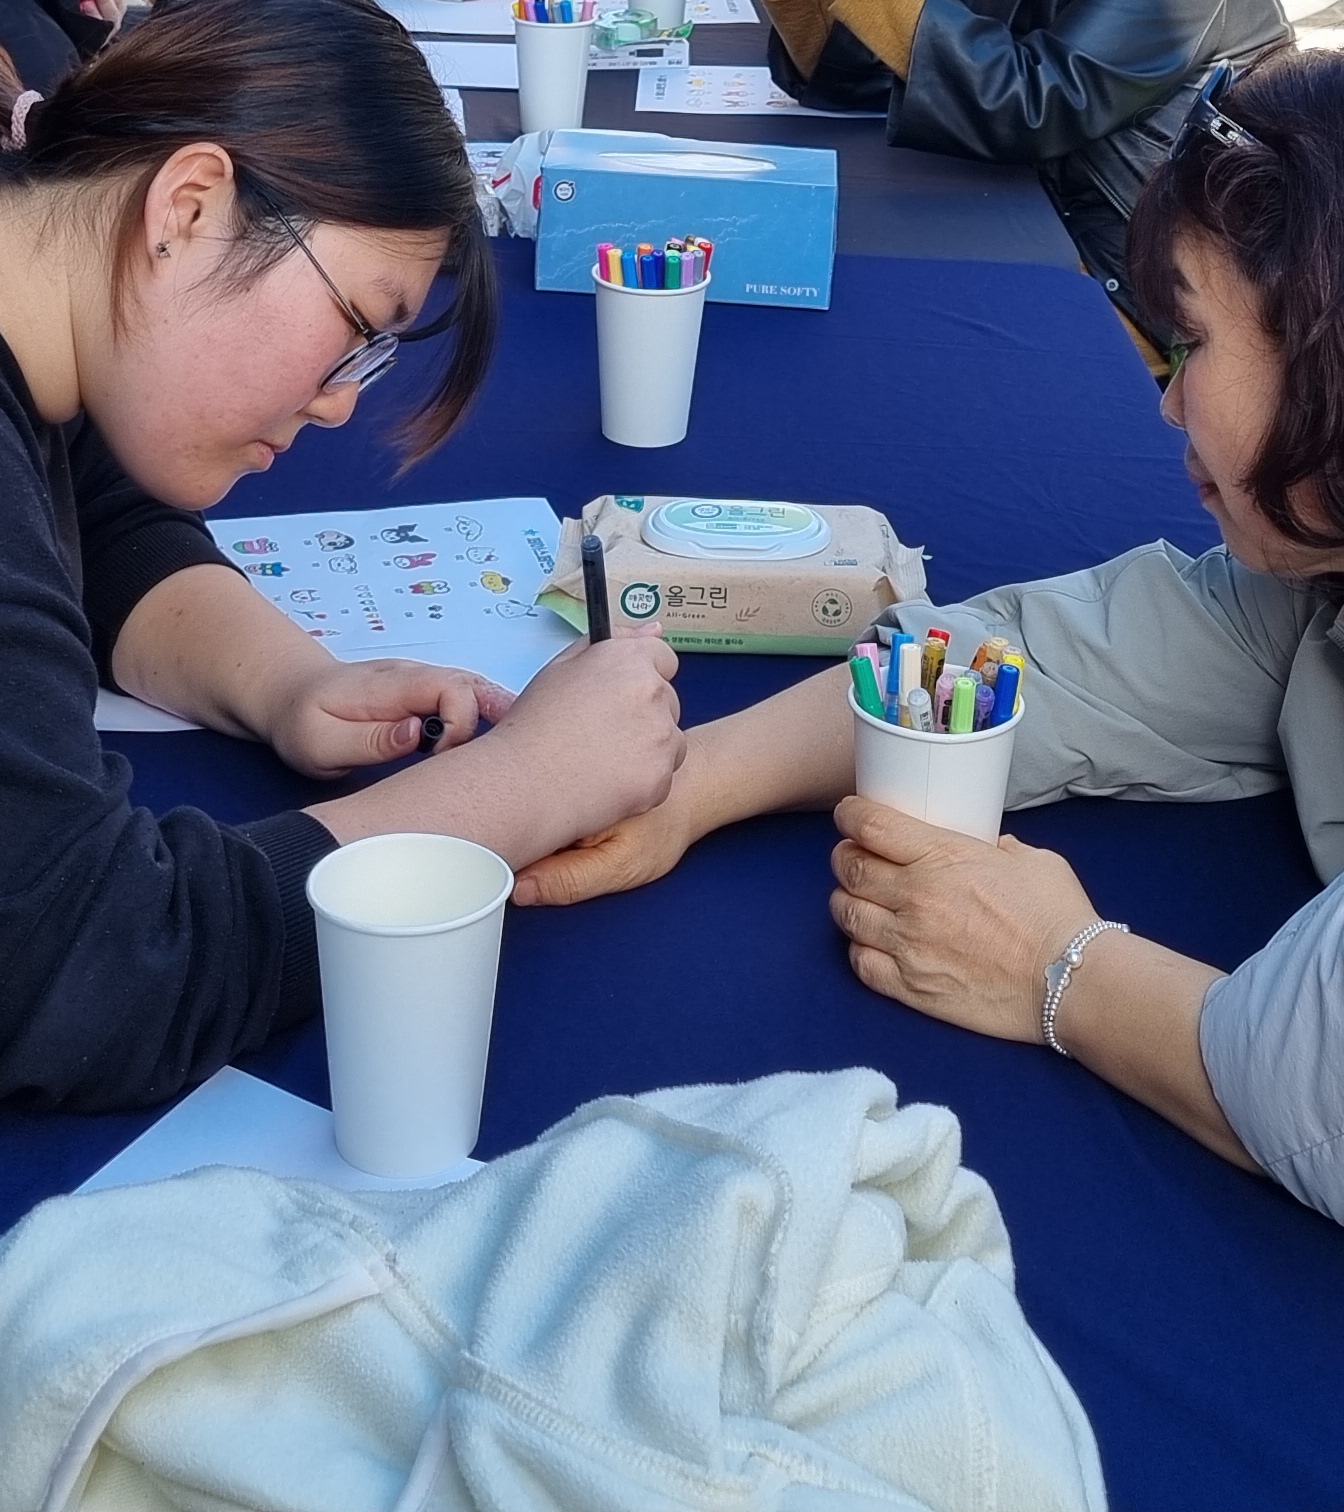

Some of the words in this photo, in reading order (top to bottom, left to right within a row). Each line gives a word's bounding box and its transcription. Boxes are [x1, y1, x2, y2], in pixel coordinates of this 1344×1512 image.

[745, 283, 777, 295] PURE
[780, 285, 820, 297] SOFTY
[665, 585, 728, 609] 올그린
